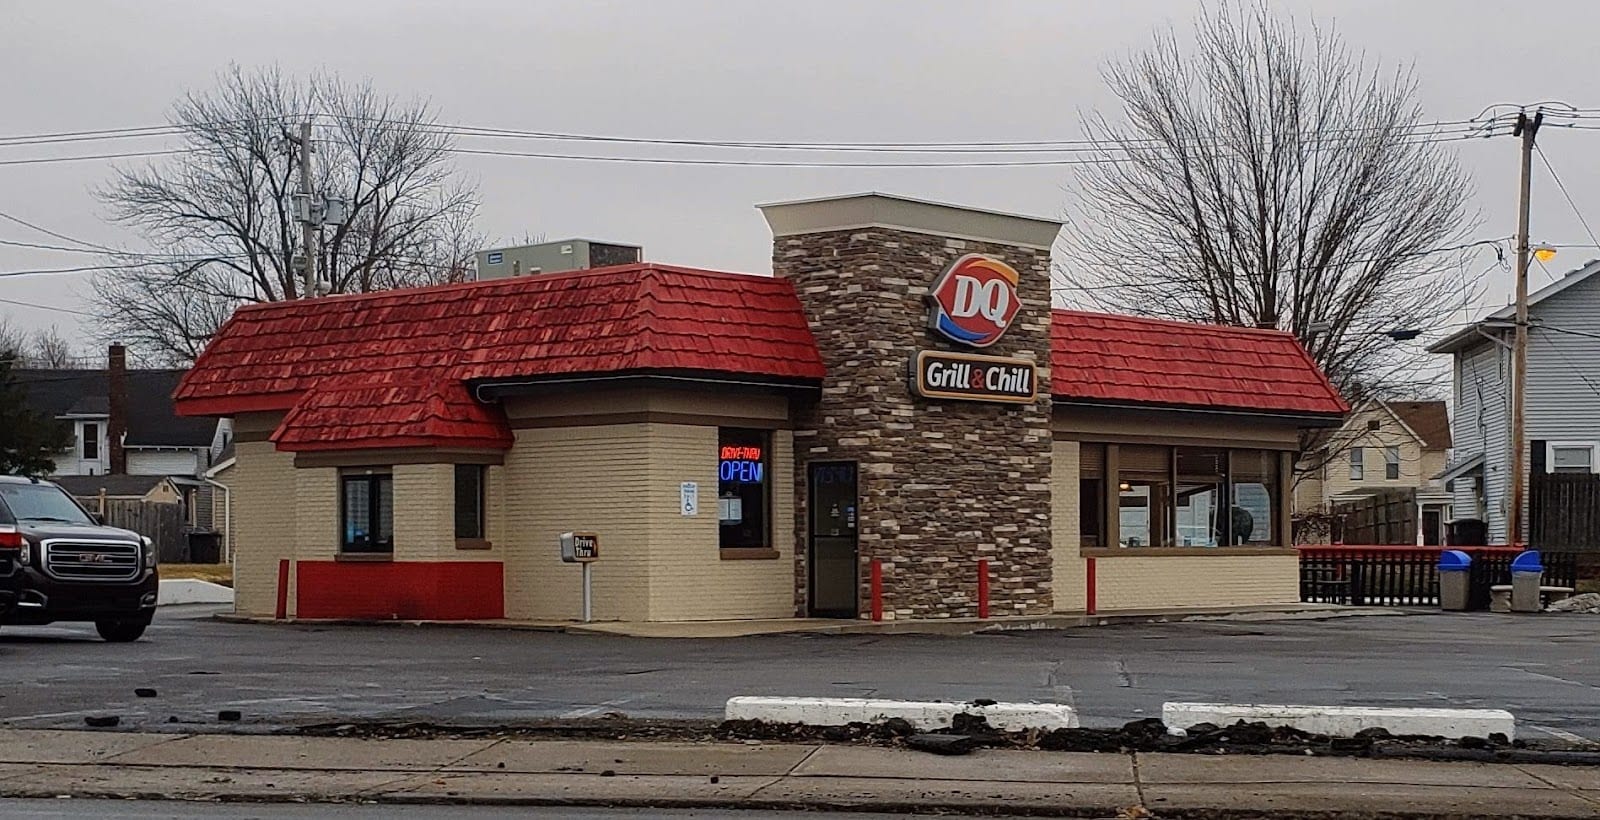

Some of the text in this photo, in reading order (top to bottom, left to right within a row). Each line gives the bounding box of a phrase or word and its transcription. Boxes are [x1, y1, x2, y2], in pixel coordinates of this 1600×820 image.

[951, 274, 1006, 328] DQ
[926, 361, 971, 388] Grill
[986, 366, 1030, 393] Chill
[720, 460, 763, 482] OPEN
[574, 536, 593, 547] Drive
[79, 553, 113, 563] GMC
